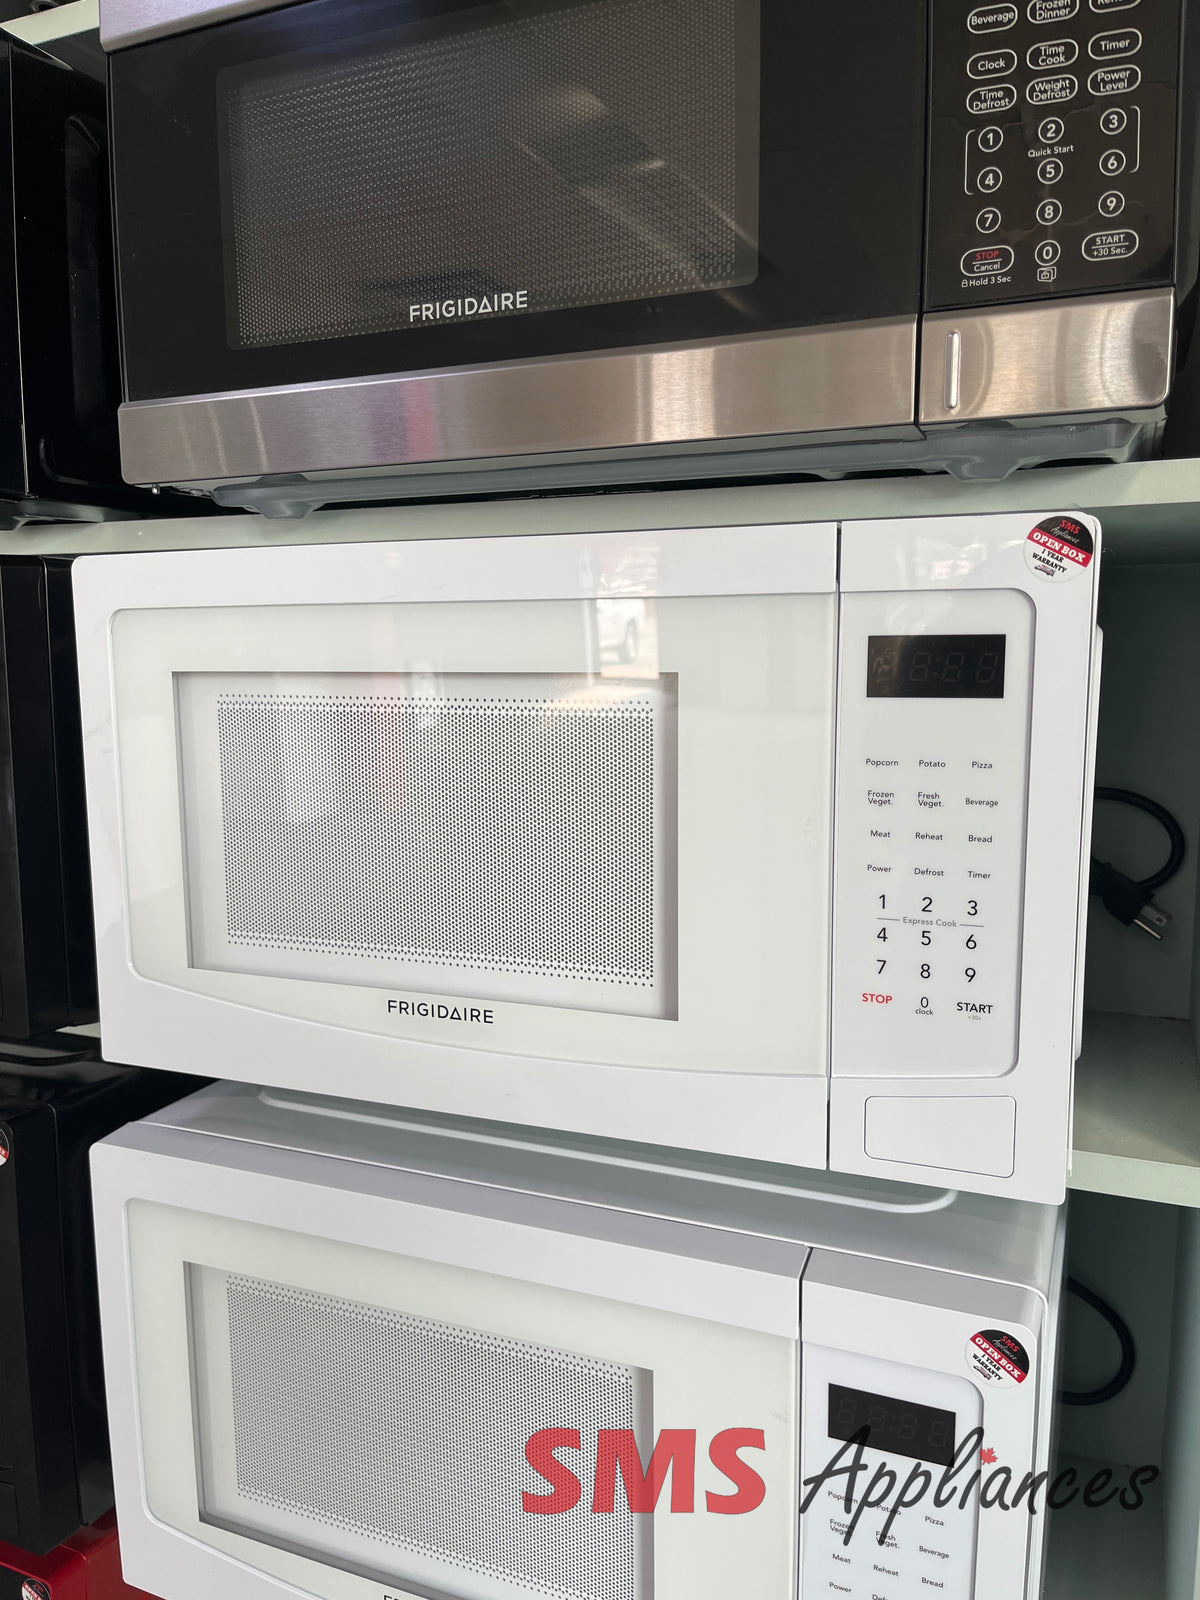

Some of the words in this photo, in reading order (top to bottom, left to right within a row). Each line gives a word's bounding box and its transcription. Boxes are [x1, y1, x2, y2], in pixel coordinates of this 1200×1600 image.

[971, 11, 1014, 26] Beverage
[1036, 8, 1070, 20] Dinner
[1040, 44, 1064, 55] Time
[1100, 39, 1130, 51] Timer
[978, 58, 1005, 71] Clock
[1039, 54, 1065, 66] Cook
[1098, 69, 1130, 82] Power
[1035, 79, 1070, 92] Weight
[1100, 79, 1128, 92] Level
[980, 90, 1004, 100] Time
[1033, 88, 1070, 101] Defrost
[973, 98, 1009, 111] Defrost
[1109, 115, 1118, 128] 3
[1047, 124, 1056, 136] 2
[987, 134, 993, 146] 1
[1028, 148, 1051, 158] Quick
[1054, 144, 1074, 154] Start
[1108, 156, 1116, 168] 6
[1047, 165, 1055, 177] 5
[985, 174, 994, 186] 4
[1108, 198, 1116, 210] 9
[1045, 206, 1053, 218] 8
[984, 214, 993, 226] 7
[1096, 234, 1125, 244] START
[976, 251, 999, 260] STOP
[1043, 247, 1051, 259] 0
[1093, 248, 1108, 256] +30
[1111, 247, 1128, 255] Sec.
[974, 262, 1000, 272] Cancel
[969, 277, 988, 286] Hold
[409, 290, 527, 322] FRIGIDAIRE
[1060, 520, 1080, 534] SMS
[1033, 533, 1061, 550] OPEN
[1061, 546, 1086, 562] BOX
[1032, 552, 1067, 573] WARRANTY
[1047, 551, 1064, 563] YEAR
[866, 758, 898, 768] Popcorn
[918, 760, 946, 768] Potato
[971, 761, 992, 769] Pizza
[867, 790, 894, 798] Frozen
[918, 792, 940, 800] Fresh
[868, 798, 894, 807] Veget.
[918, 800, 944, 808] Veget.
[965, 798, 998, 808] Beverage
[870, 830, 890, 838] Meat
[915, 832, 943, 840] Reheat
[968, 835, 992, 843] Bread
[914, 868, 944, 876] Defrost
[968, 871, 991, 879] Timer
[879, 894, 886, 909] 1
[922, 897, 933, 912] 2
[967, 900, 978, 916] 3
[903, 917, 933, 926] Express
[936, 919, 957, 927] Cook
[877, 927, 888, 942] 4
[920, 930, 931, 946] 5
[966, 934, 977, 949] 6
[876, 960, 887, 974] 7
[920, 964, 931, 979] 8
[965, 967, 976, 982] 9
[862, 993, 893, 1004] STOP
[920, 997, 929, 1008] 0
[387, 1000, 494, 1024] FRIGIDAIRE
[956, 1002, 993, 1014] START
[1000, 1336, 1020, 1352] SMS
[975, 1337, 1000, 1360] OPEN
[1000, 1358, 1021, 1378] BOX
[972, 1353, 1003, 1380] WARRANTY
[986, 1357, 1001, 1371] YEAR
[925, 1515, 944, 1527] Pizza
[919, 1545, 950, 1559] Beverage
[832, 1554, 851, 1564] Meat
[873, 1564, 899, 1577] Reheat
[829, 1582, 852, 1593] Power
[922, 1577, 944, 1588] Bread
